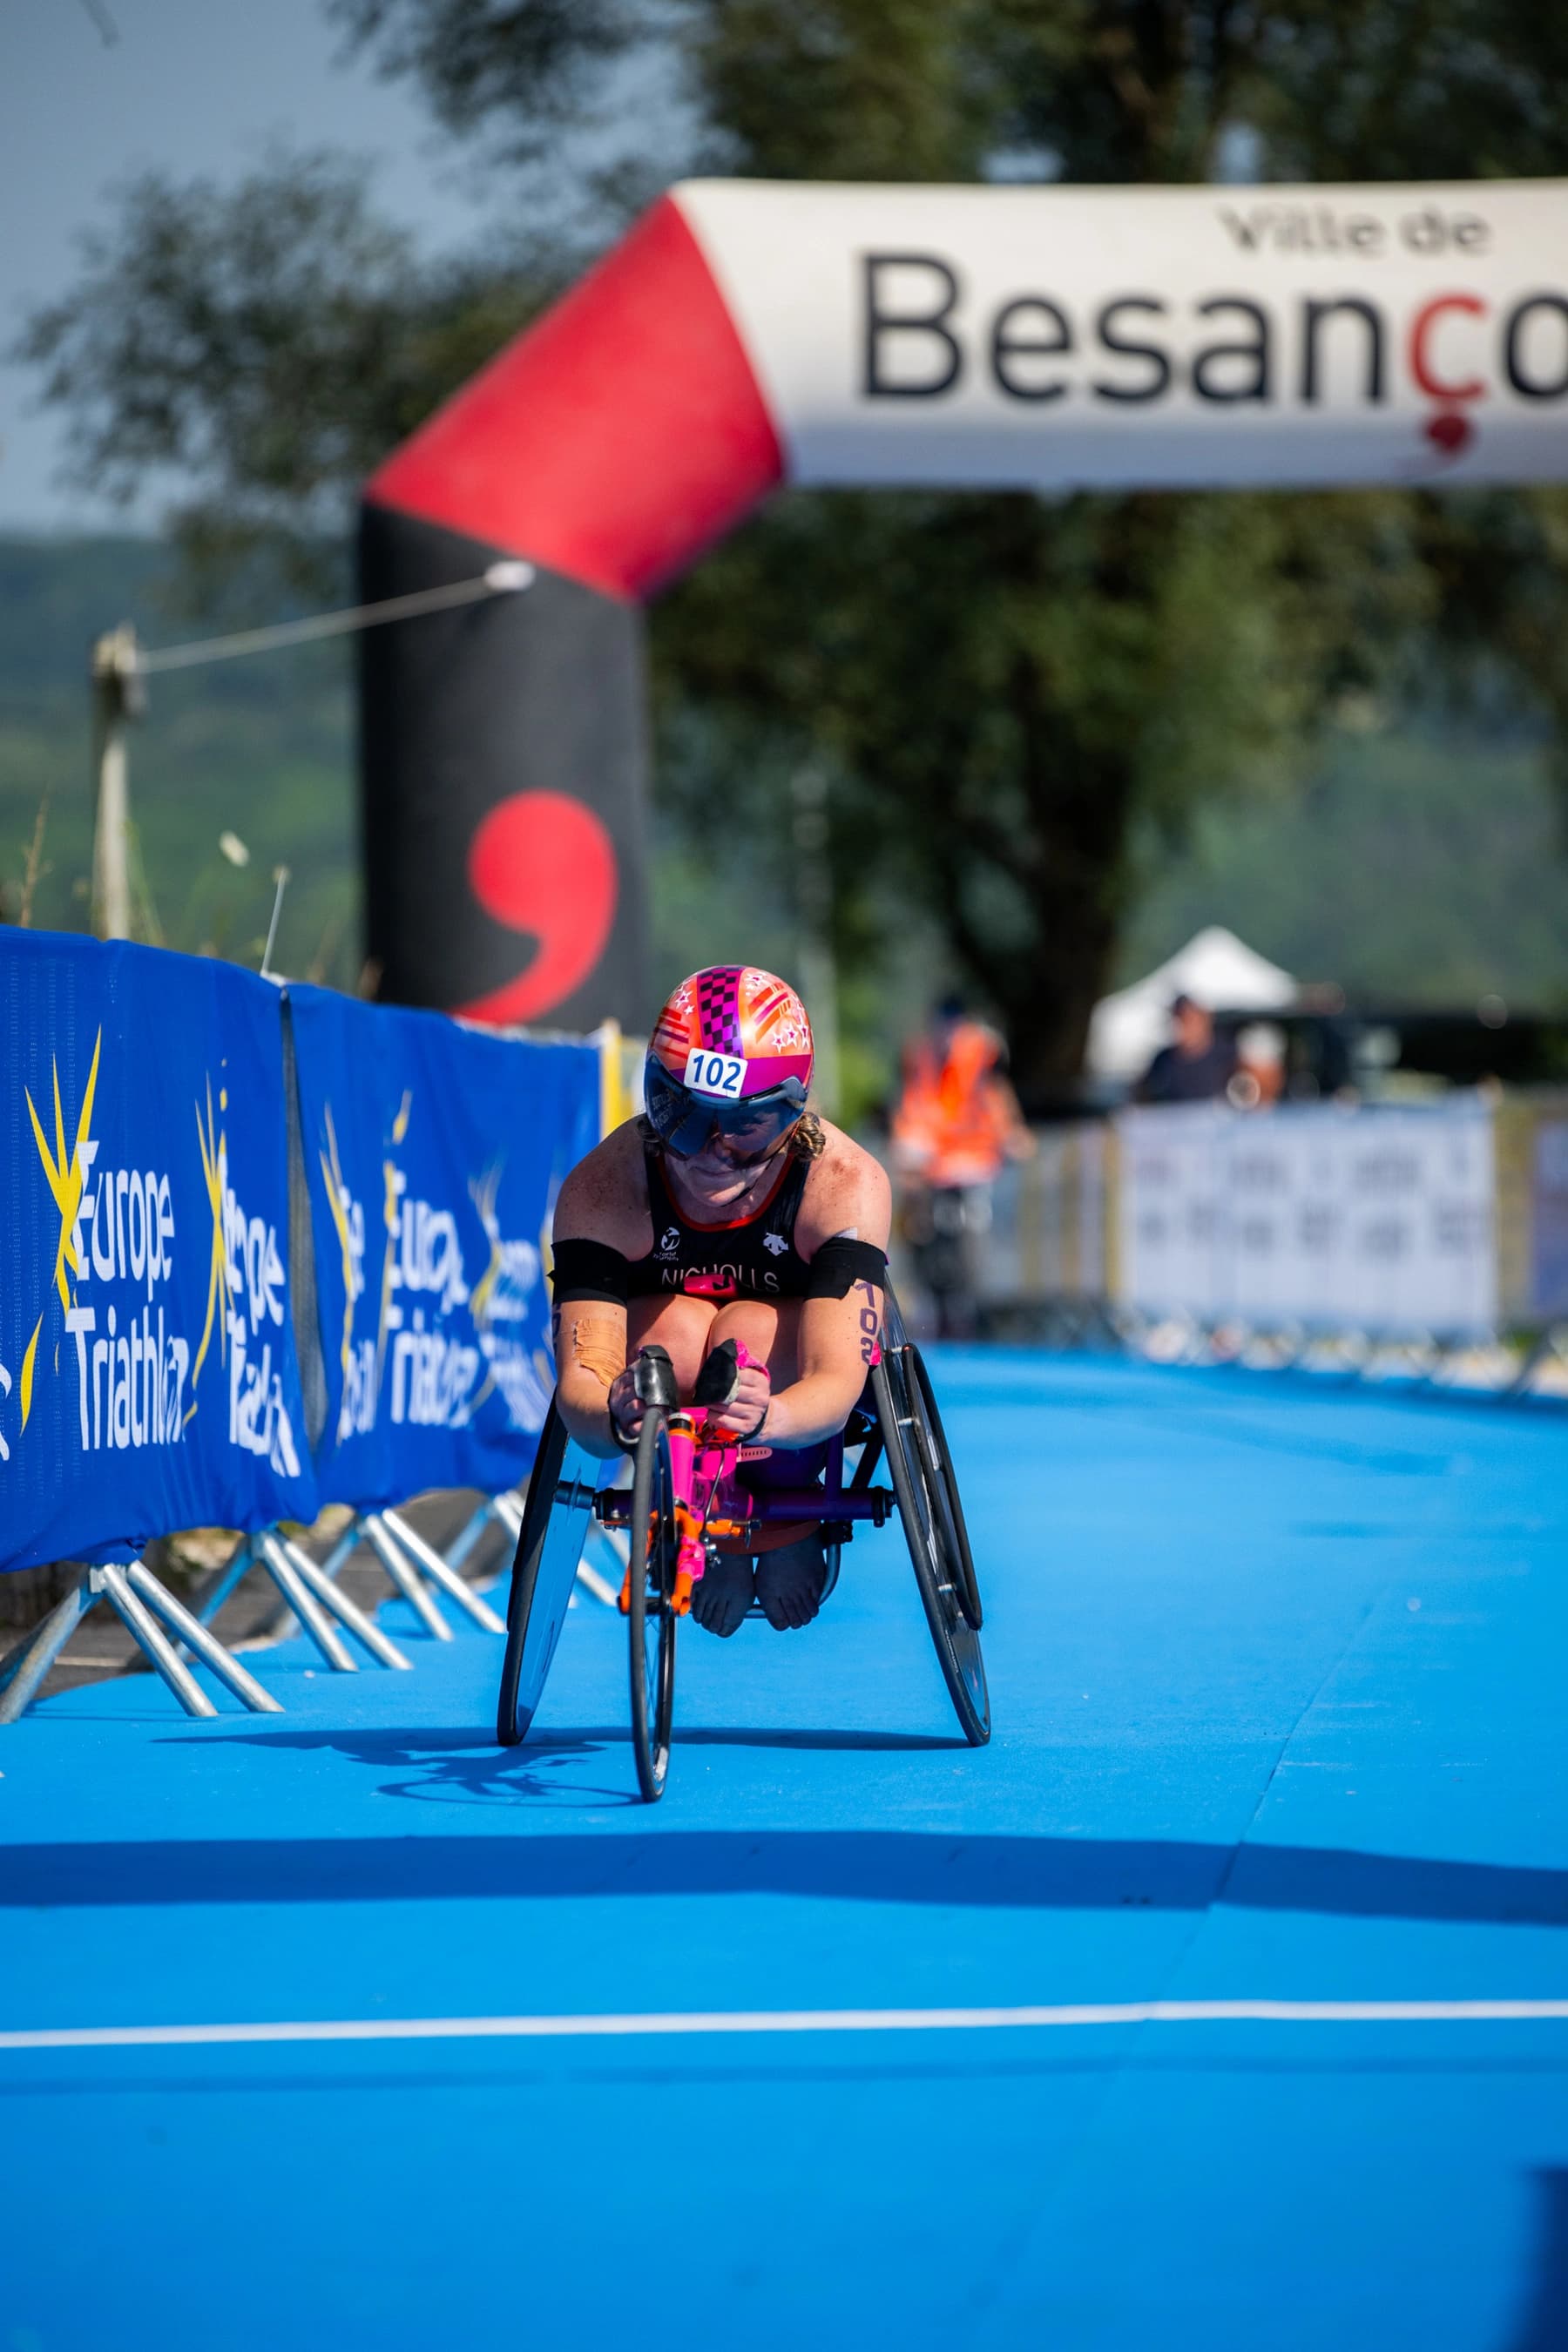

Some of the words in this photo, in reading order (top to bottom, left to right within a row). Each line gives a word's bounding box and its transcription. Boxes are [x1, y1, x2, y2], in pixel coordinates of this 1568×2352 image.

[1217, 204, 1383, 254] Ville
[1399, 202, 1490, 254] de
[693, 1053, 741, 1092] 102
[71, 1139, 175, 1303] Europe
